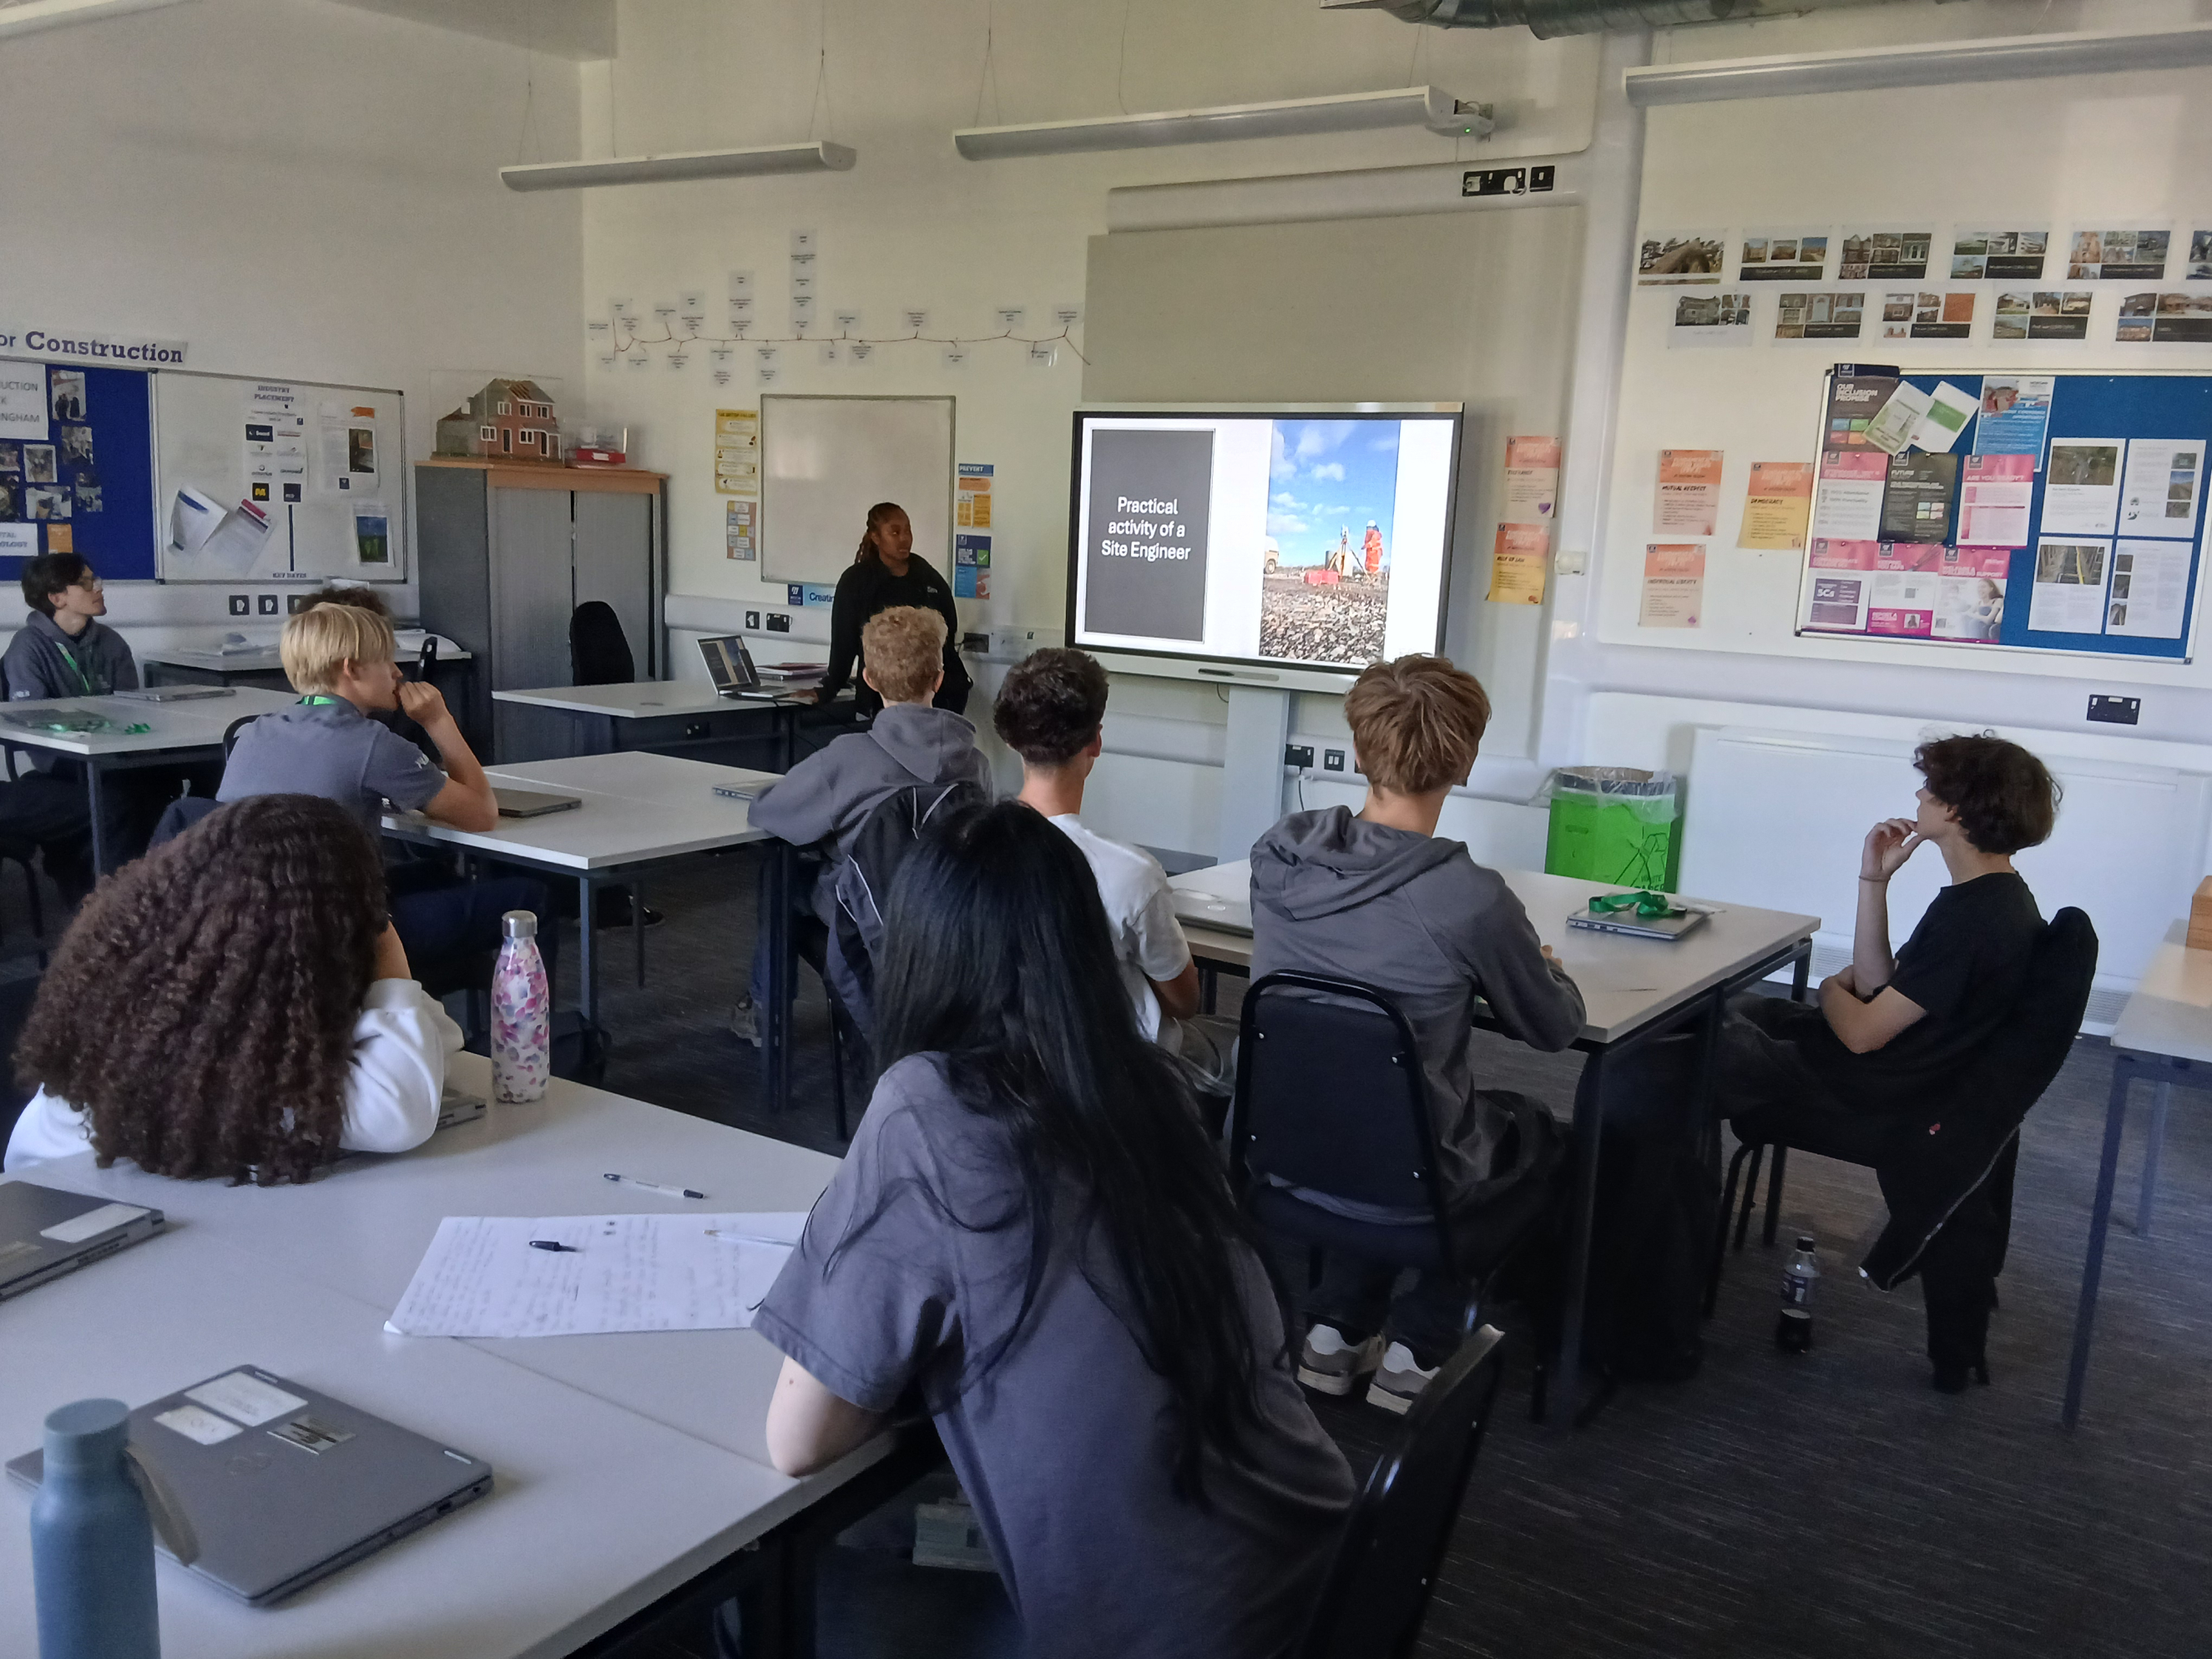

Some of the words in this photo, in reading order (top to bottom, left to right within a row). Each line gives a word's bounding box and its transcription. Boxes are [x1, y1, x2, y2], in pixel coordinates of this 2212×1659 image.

[25, 330, 184, 363] Construction
[1117, 496, 1179, 515] Practical
[1108, 519, 1158, 539] activity
[1159, 520, 1175, 537] of
[1176, 524, 1186, 537] a
[1101, 539, 1129, 557] Site
[1130, 541, 1192, 562] Engineer
